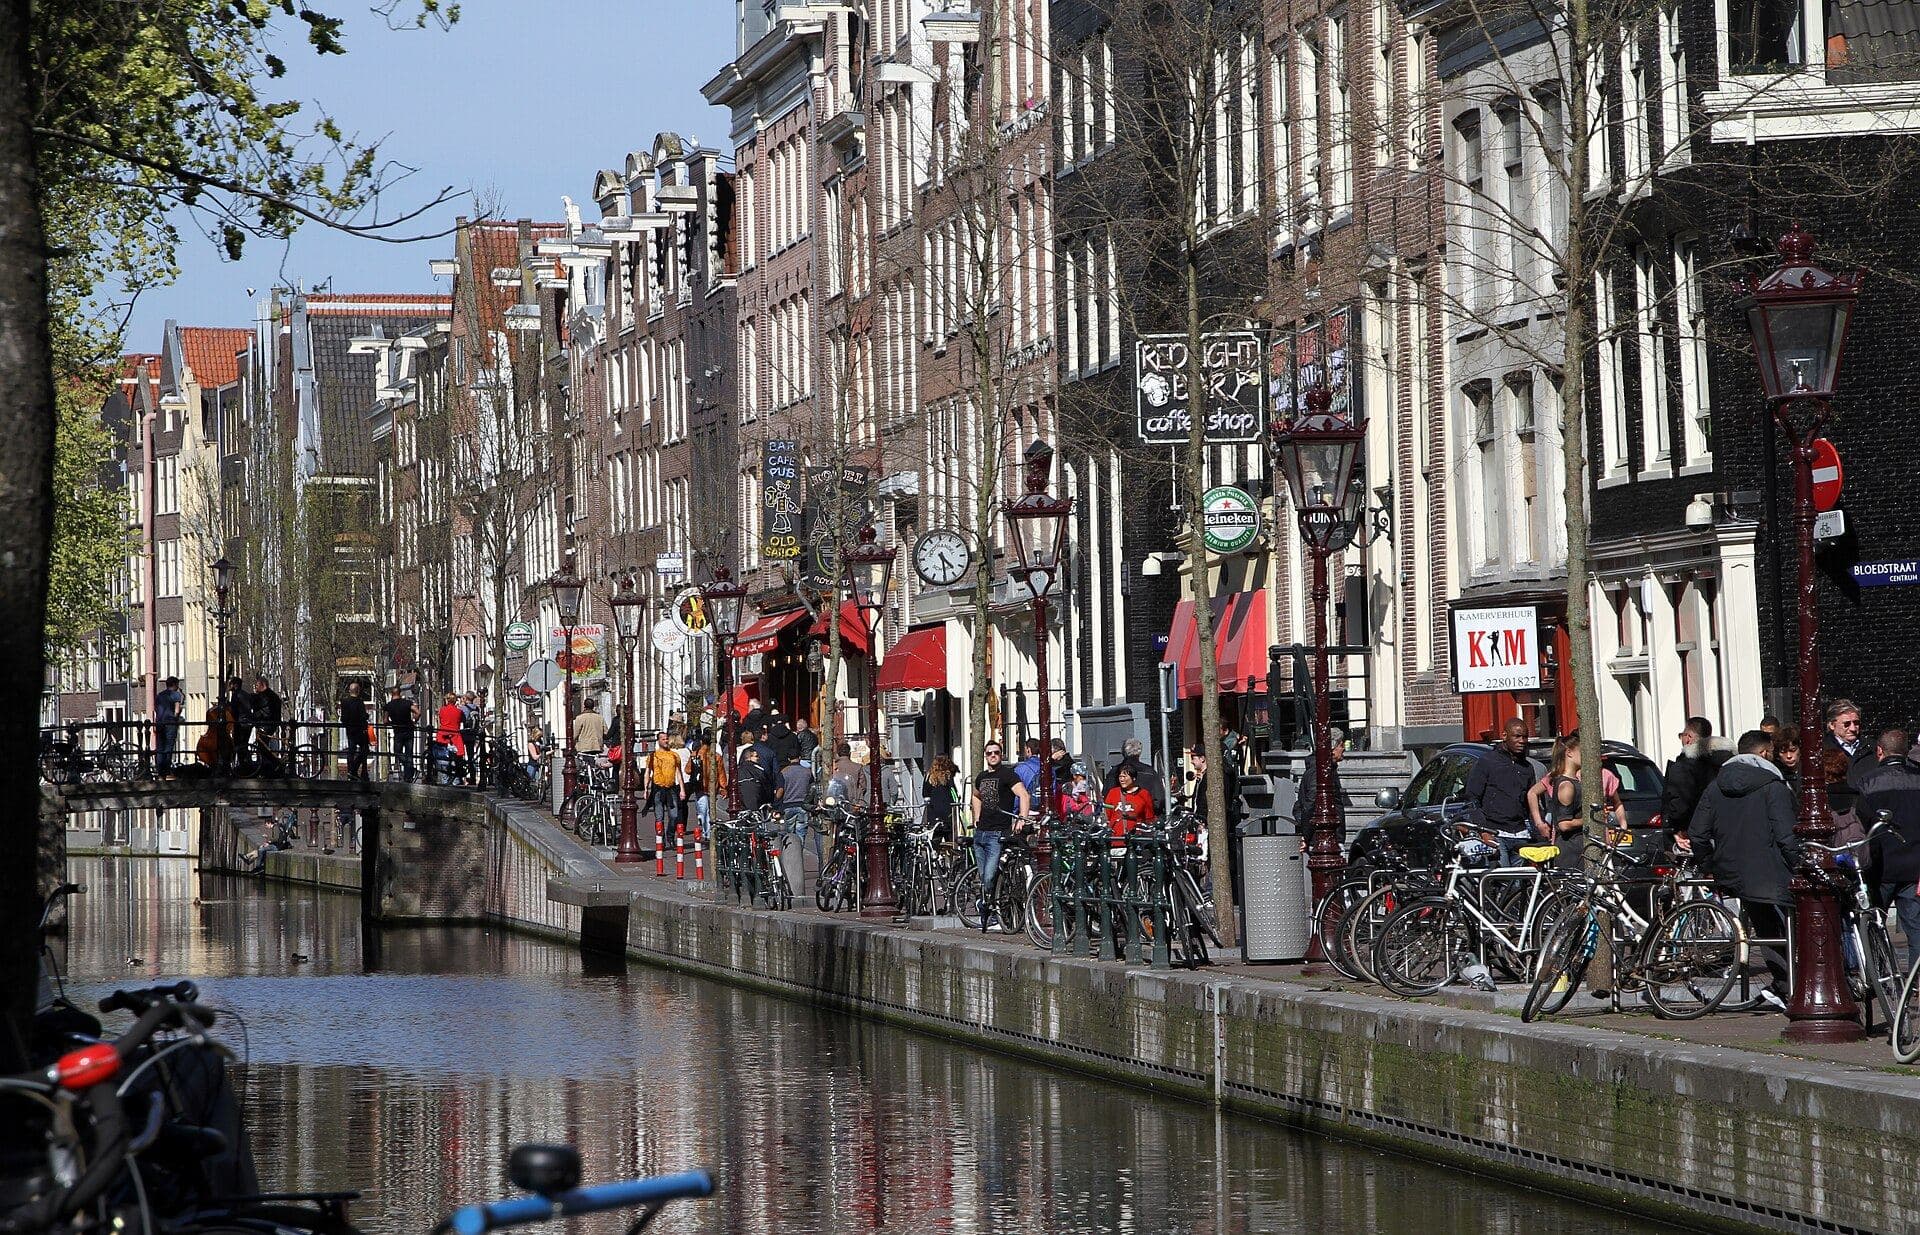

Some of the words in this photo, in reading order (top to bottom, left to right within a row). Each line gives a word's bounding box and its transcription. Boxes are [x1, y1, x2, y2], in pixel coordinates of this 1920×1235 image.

[1142, 342, 1188, 372] RED
[1200, 341, 1257, 368] IGHT
[1147, 408, 1204, 432] coffe
[1207, 407, 1255, 437] shop
[769, 441, 795, 451] BAR
[769, 467, 795, 478] PUB
[770, 535, 796, 547] OLD
[765, 546, 800, 557] SAILOR
[1854, 562, 1917, 576] BLOEDSTRAAT
[813, 575, 835, 585] ROYA
[1889, 574, 1918, 582] CENTRUM
[1459, 610, 1534, 621] KAMERVERHUUR
[553, 627, 601, 638] SHARMA
[1462, 679, 1476, 690] 06
[1485, 676, 1536, 689] 22801827
